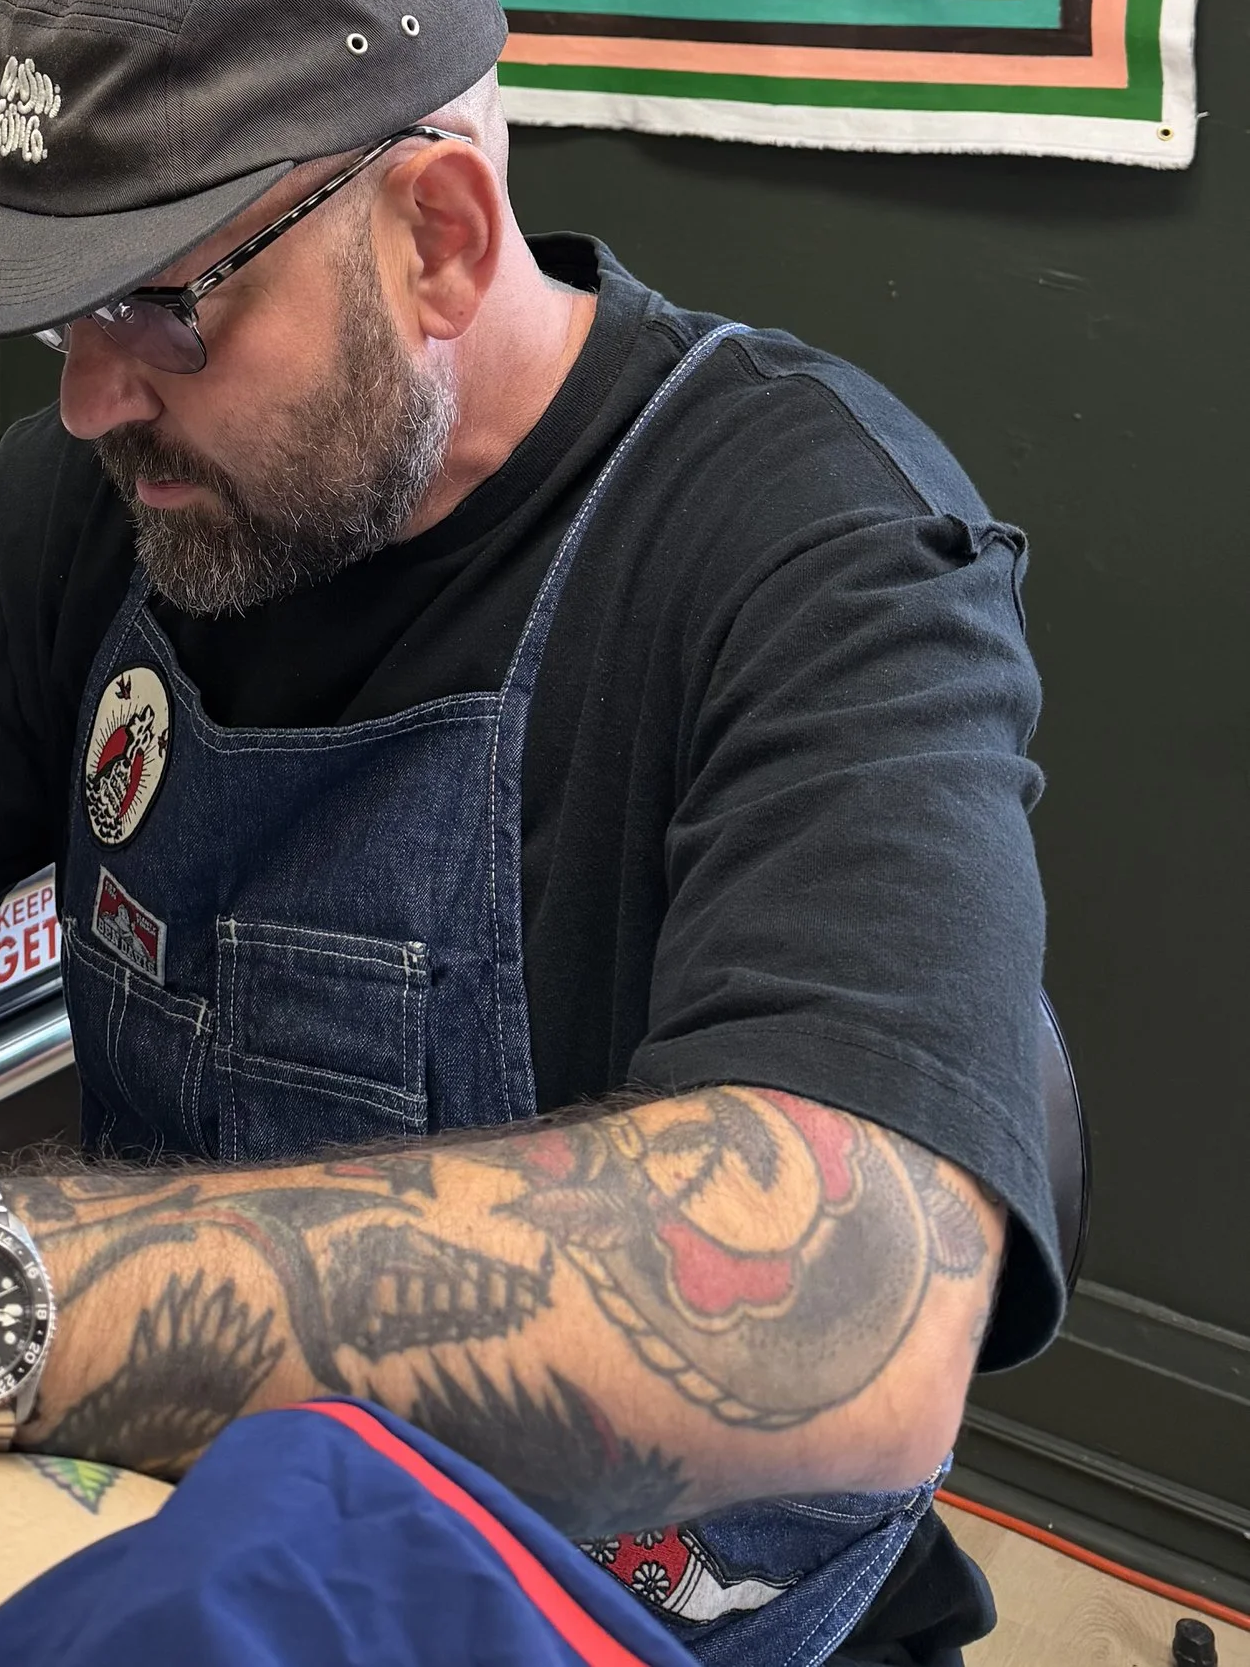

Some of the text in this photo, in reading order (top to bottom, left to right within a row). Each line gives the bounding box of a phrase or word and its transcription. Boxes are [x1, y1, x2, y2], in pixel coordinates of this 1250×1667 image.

[98, 917, 119, 948] BEN
[121, 938, 156, 975] DAVIS
[24, 1261, 41, 1279] 16
[24, 1342, 41, 1364] 20
